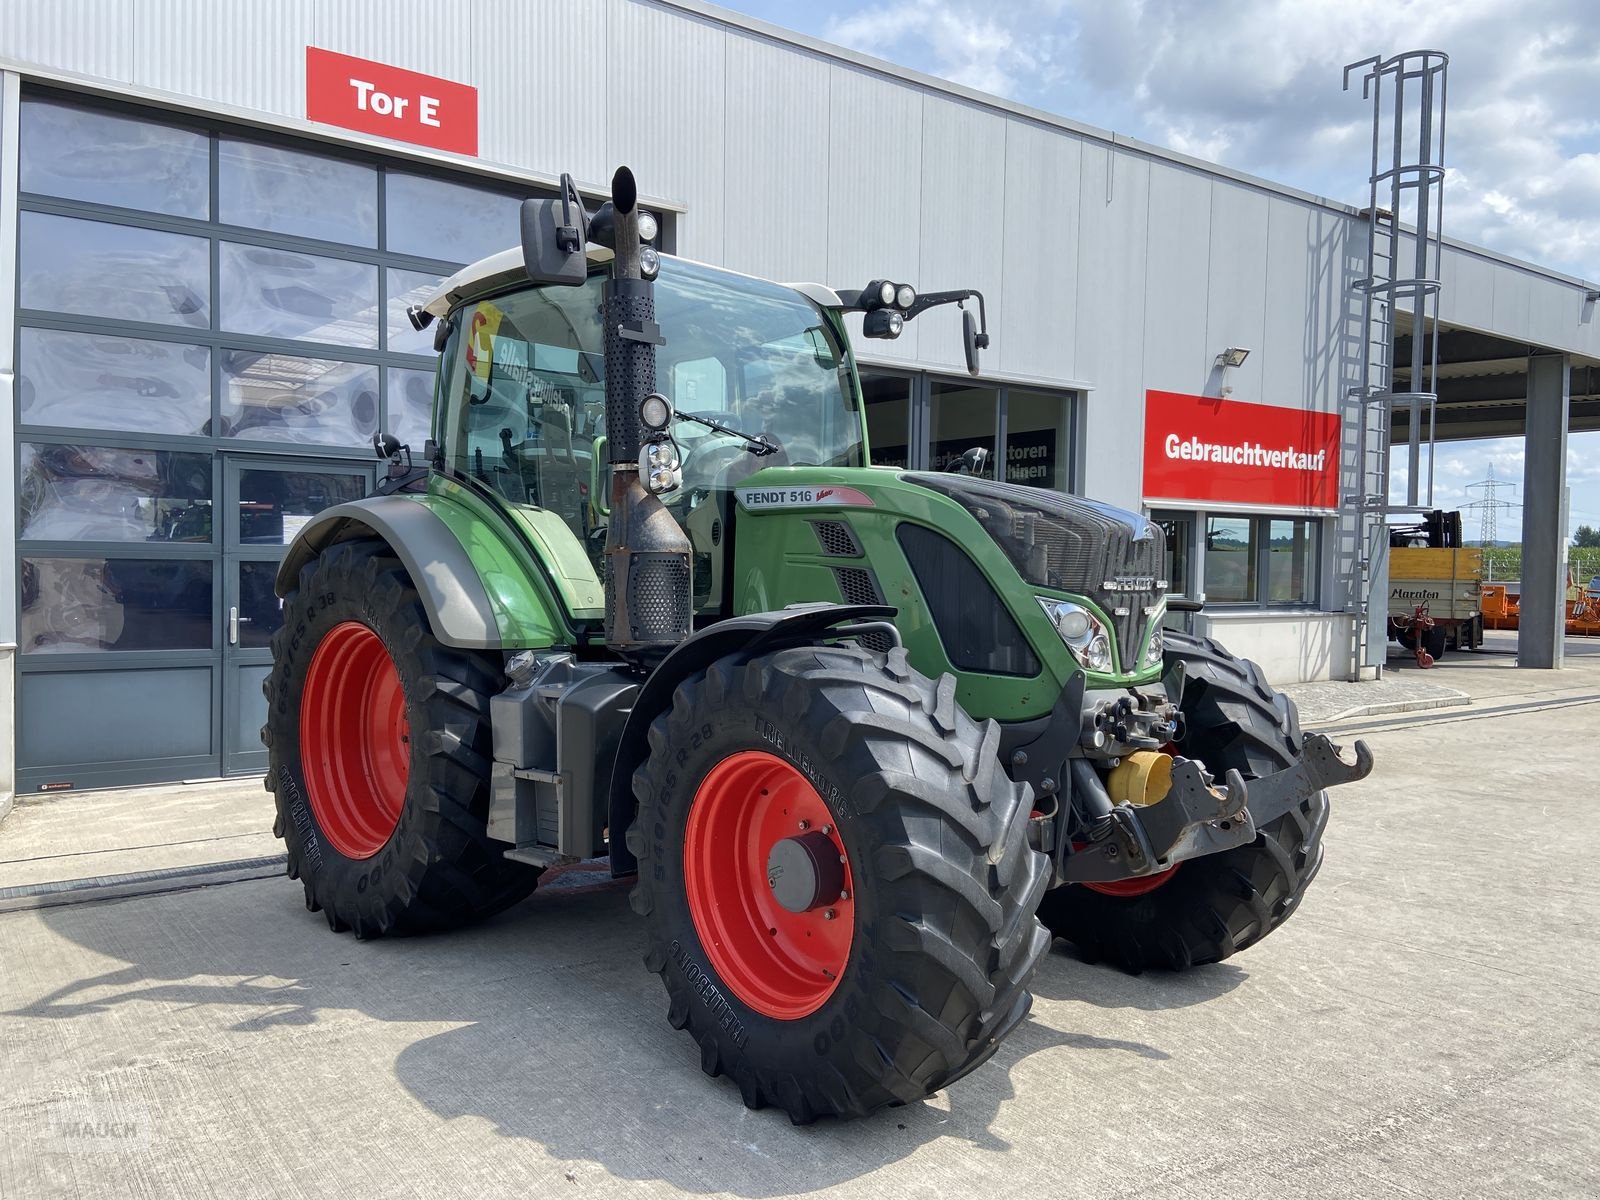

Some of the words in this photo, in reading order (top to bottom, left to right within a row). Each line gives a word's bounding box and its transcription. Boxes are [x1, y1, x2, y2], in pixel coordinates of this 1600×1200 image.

[349, 78, 408, 119] Tor
[419, 95, 441, 128] E
[1165, 433, 1325, 471] Gebrauchtverkauf
[746, 491, 786, 504] FENDT
[790, 490, 812, 502] 516
[1114, 576, 1155, 591] FENDT
[1391, 588, 1439, 600] Maraton
[317, 592, 336, 610] 38
[690, 722, 714, 750] 28
[754, 713, 851, 819] TRELLEBORG
